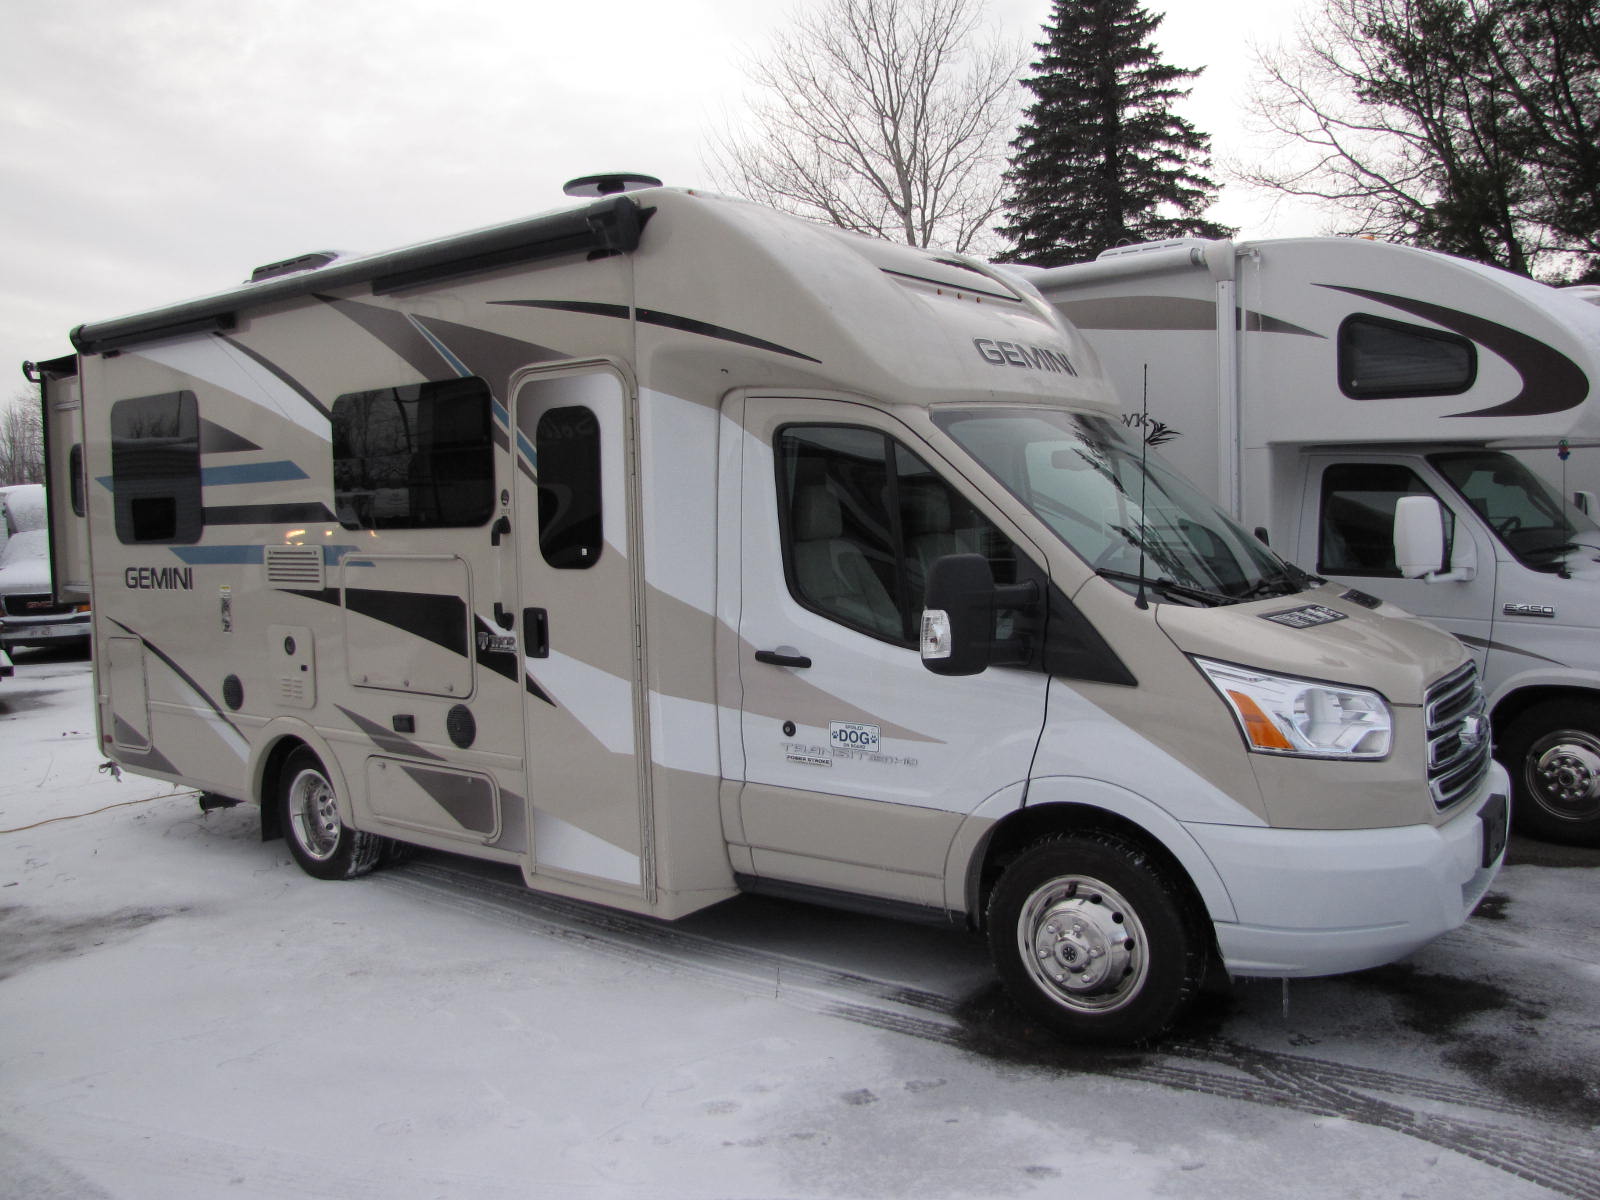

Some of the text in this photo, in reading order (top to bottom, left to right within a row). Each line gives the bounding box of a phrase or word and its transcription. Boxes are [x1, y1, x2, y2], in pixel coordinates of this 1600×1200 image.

[972, 337, 1079, 378] GEMINI
[125, 566, 193, 590] GEMINI
[839, 729, 870, 745] DOG
